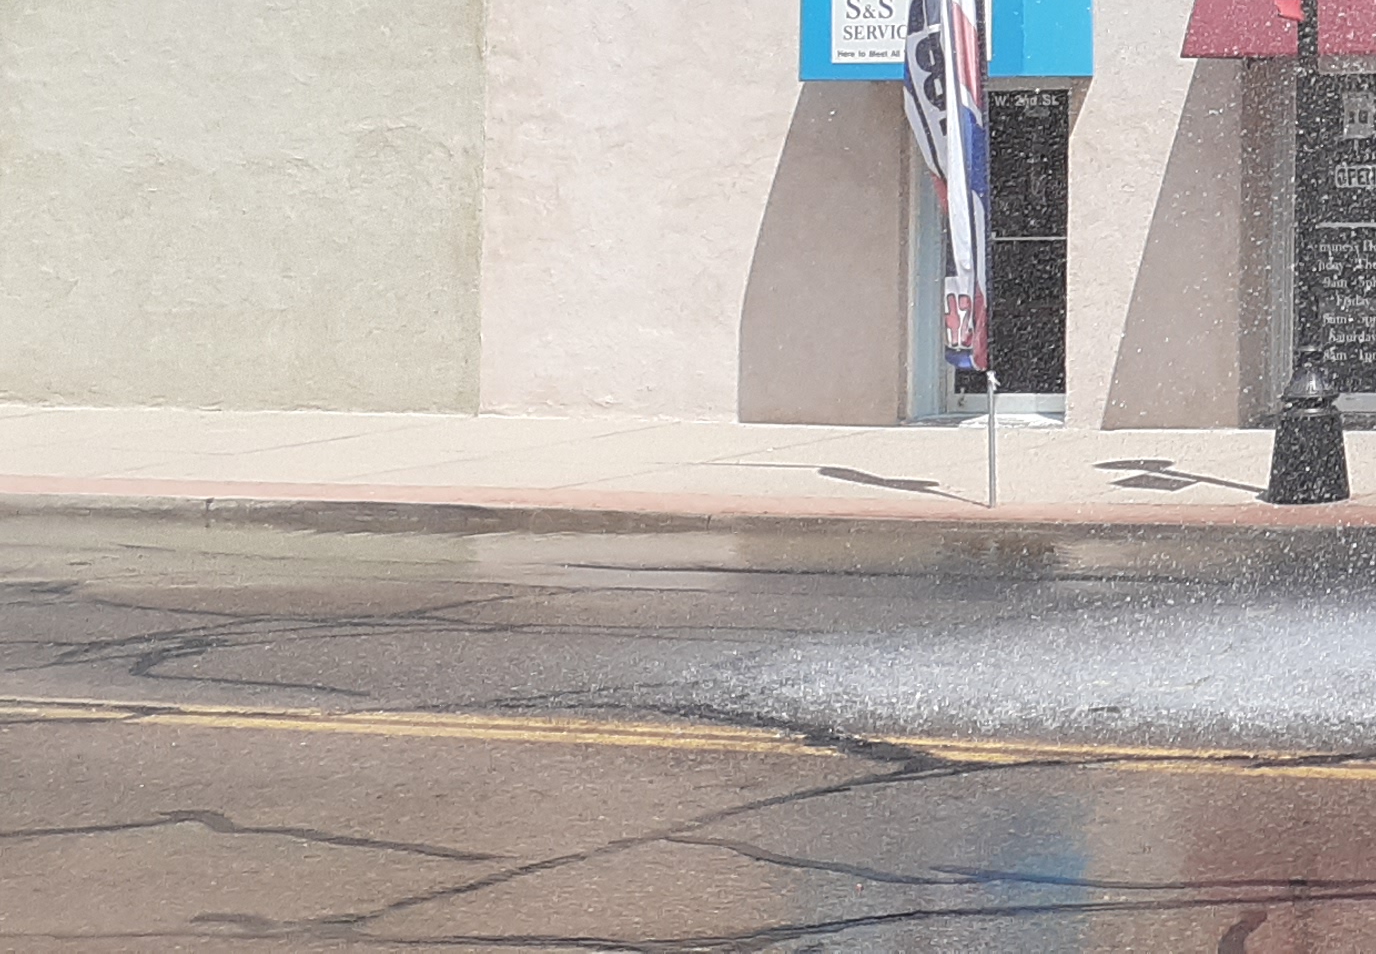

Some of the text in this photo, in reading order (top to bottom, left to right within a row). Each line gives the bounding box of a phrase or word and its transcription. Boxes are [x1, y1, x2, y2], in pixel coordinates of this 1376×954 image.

[843, 24, 908, 41] SERVIC
[837, 49, 855, 58] Here
[858, 50, 866, 58] to
